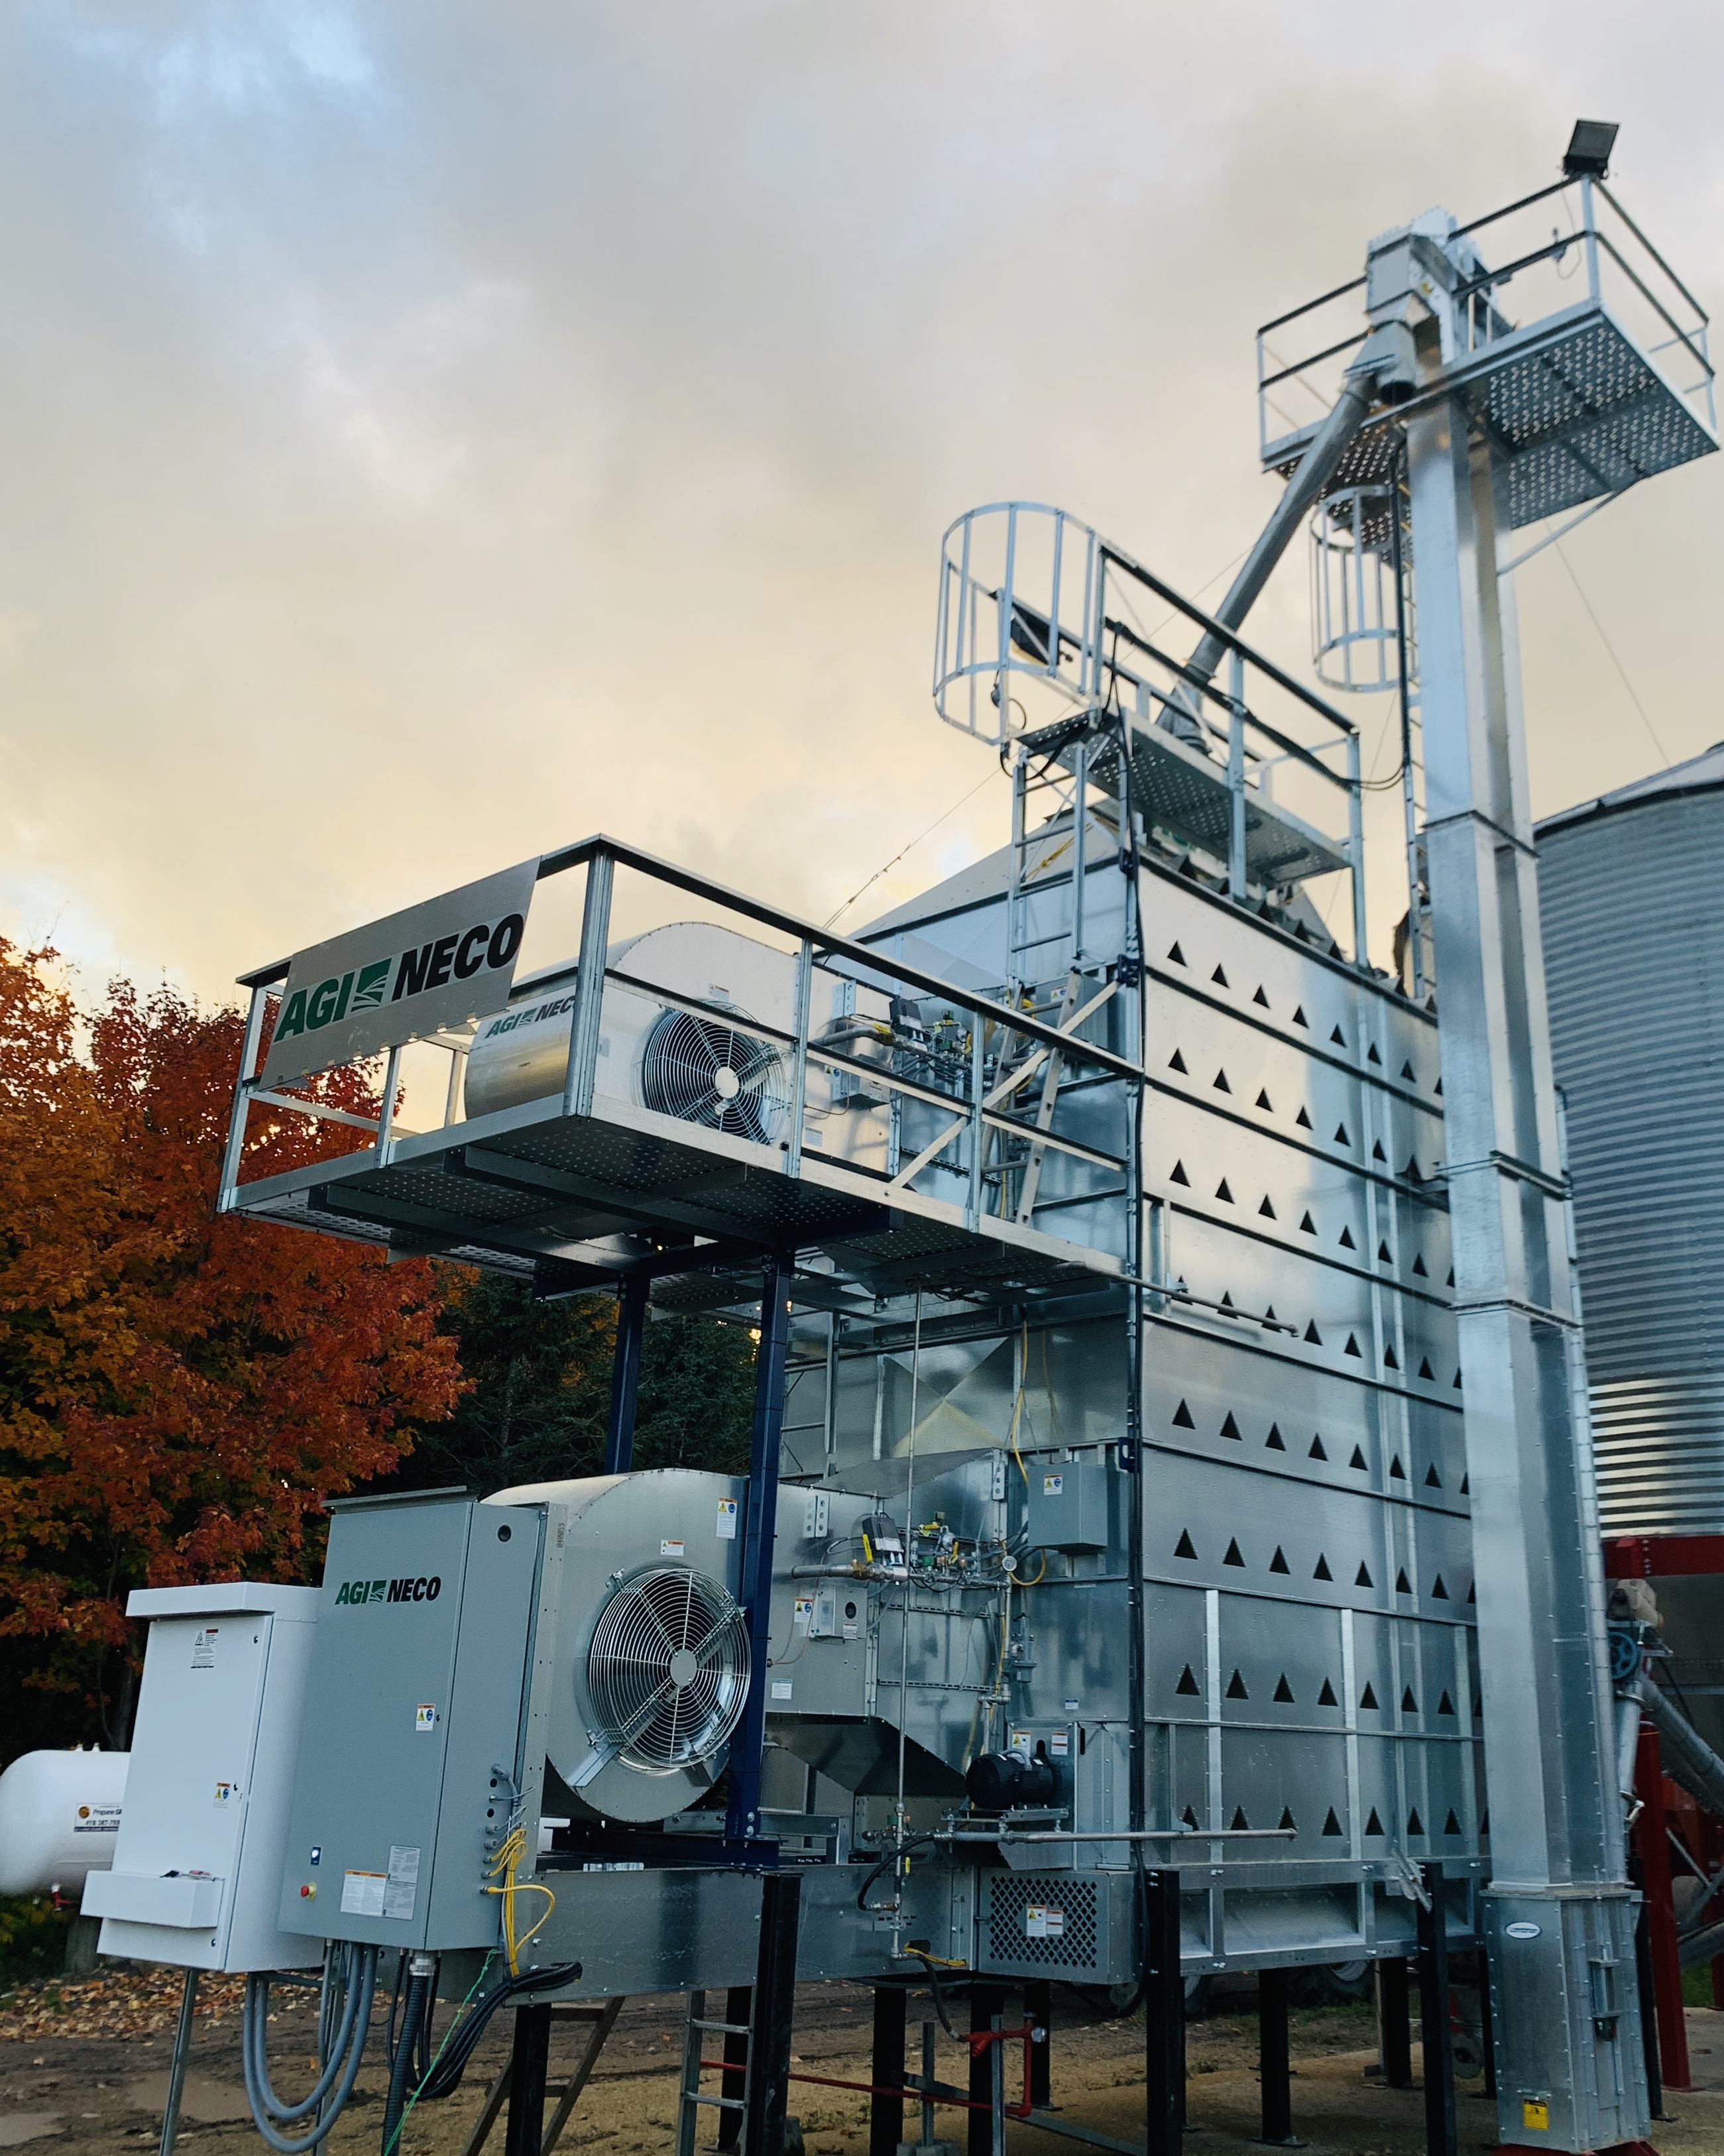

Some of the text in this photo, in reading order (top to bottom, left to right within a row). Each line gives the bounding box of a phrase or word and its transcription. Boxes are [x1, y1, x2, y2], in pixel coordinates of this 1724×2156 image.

[274, 913, 524, 1043] AGI NECO
[485, 995, 576, 1039] AGI NEC
[335, 1577, 441, 1605] AGI NECO
